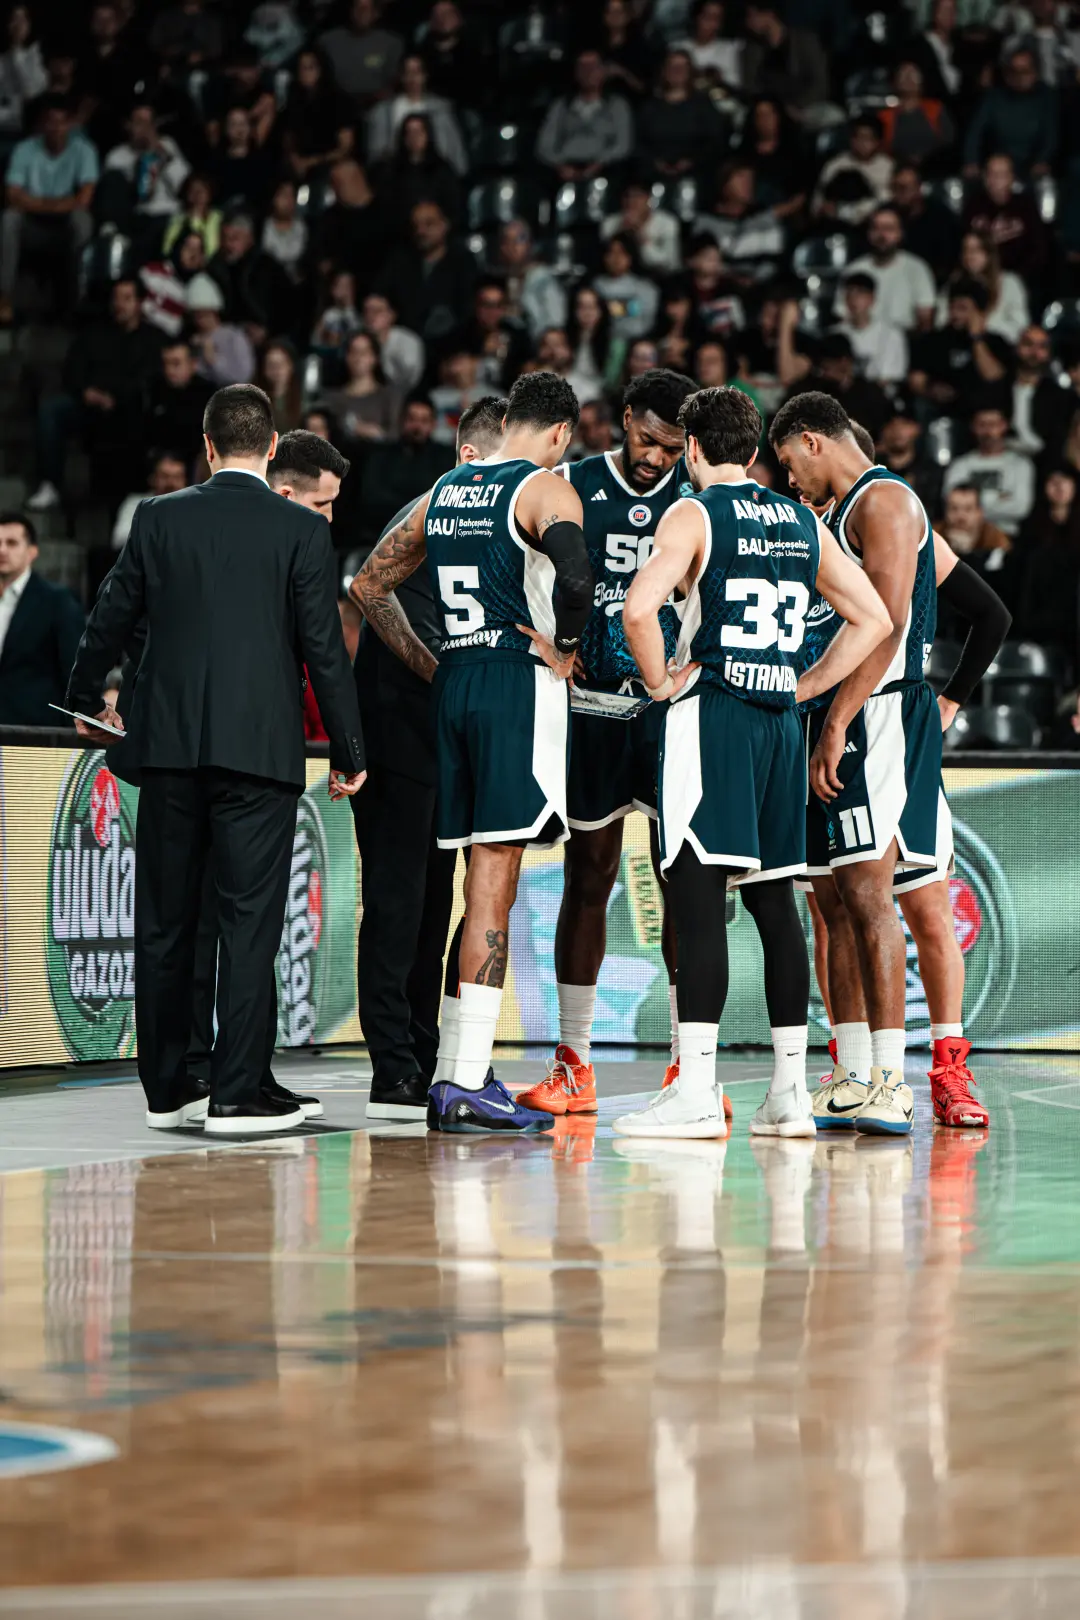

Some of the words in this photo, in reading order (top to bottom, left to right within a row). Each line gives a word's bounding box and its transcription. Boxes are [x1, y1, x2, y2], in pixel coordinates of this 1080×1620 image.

[434, 484, 504, 508] HOMESLEY
[427, 518, 455, 536] BAU
[738, 538, 769, 556] BAU
[437, 565, 485, 636] 5
[720, 578, 810, 653] 33
[839, 805, 873, 849] 11
[52, 823, 136, 939] uluda
[69, 952, 135, 998] GAZOZ
